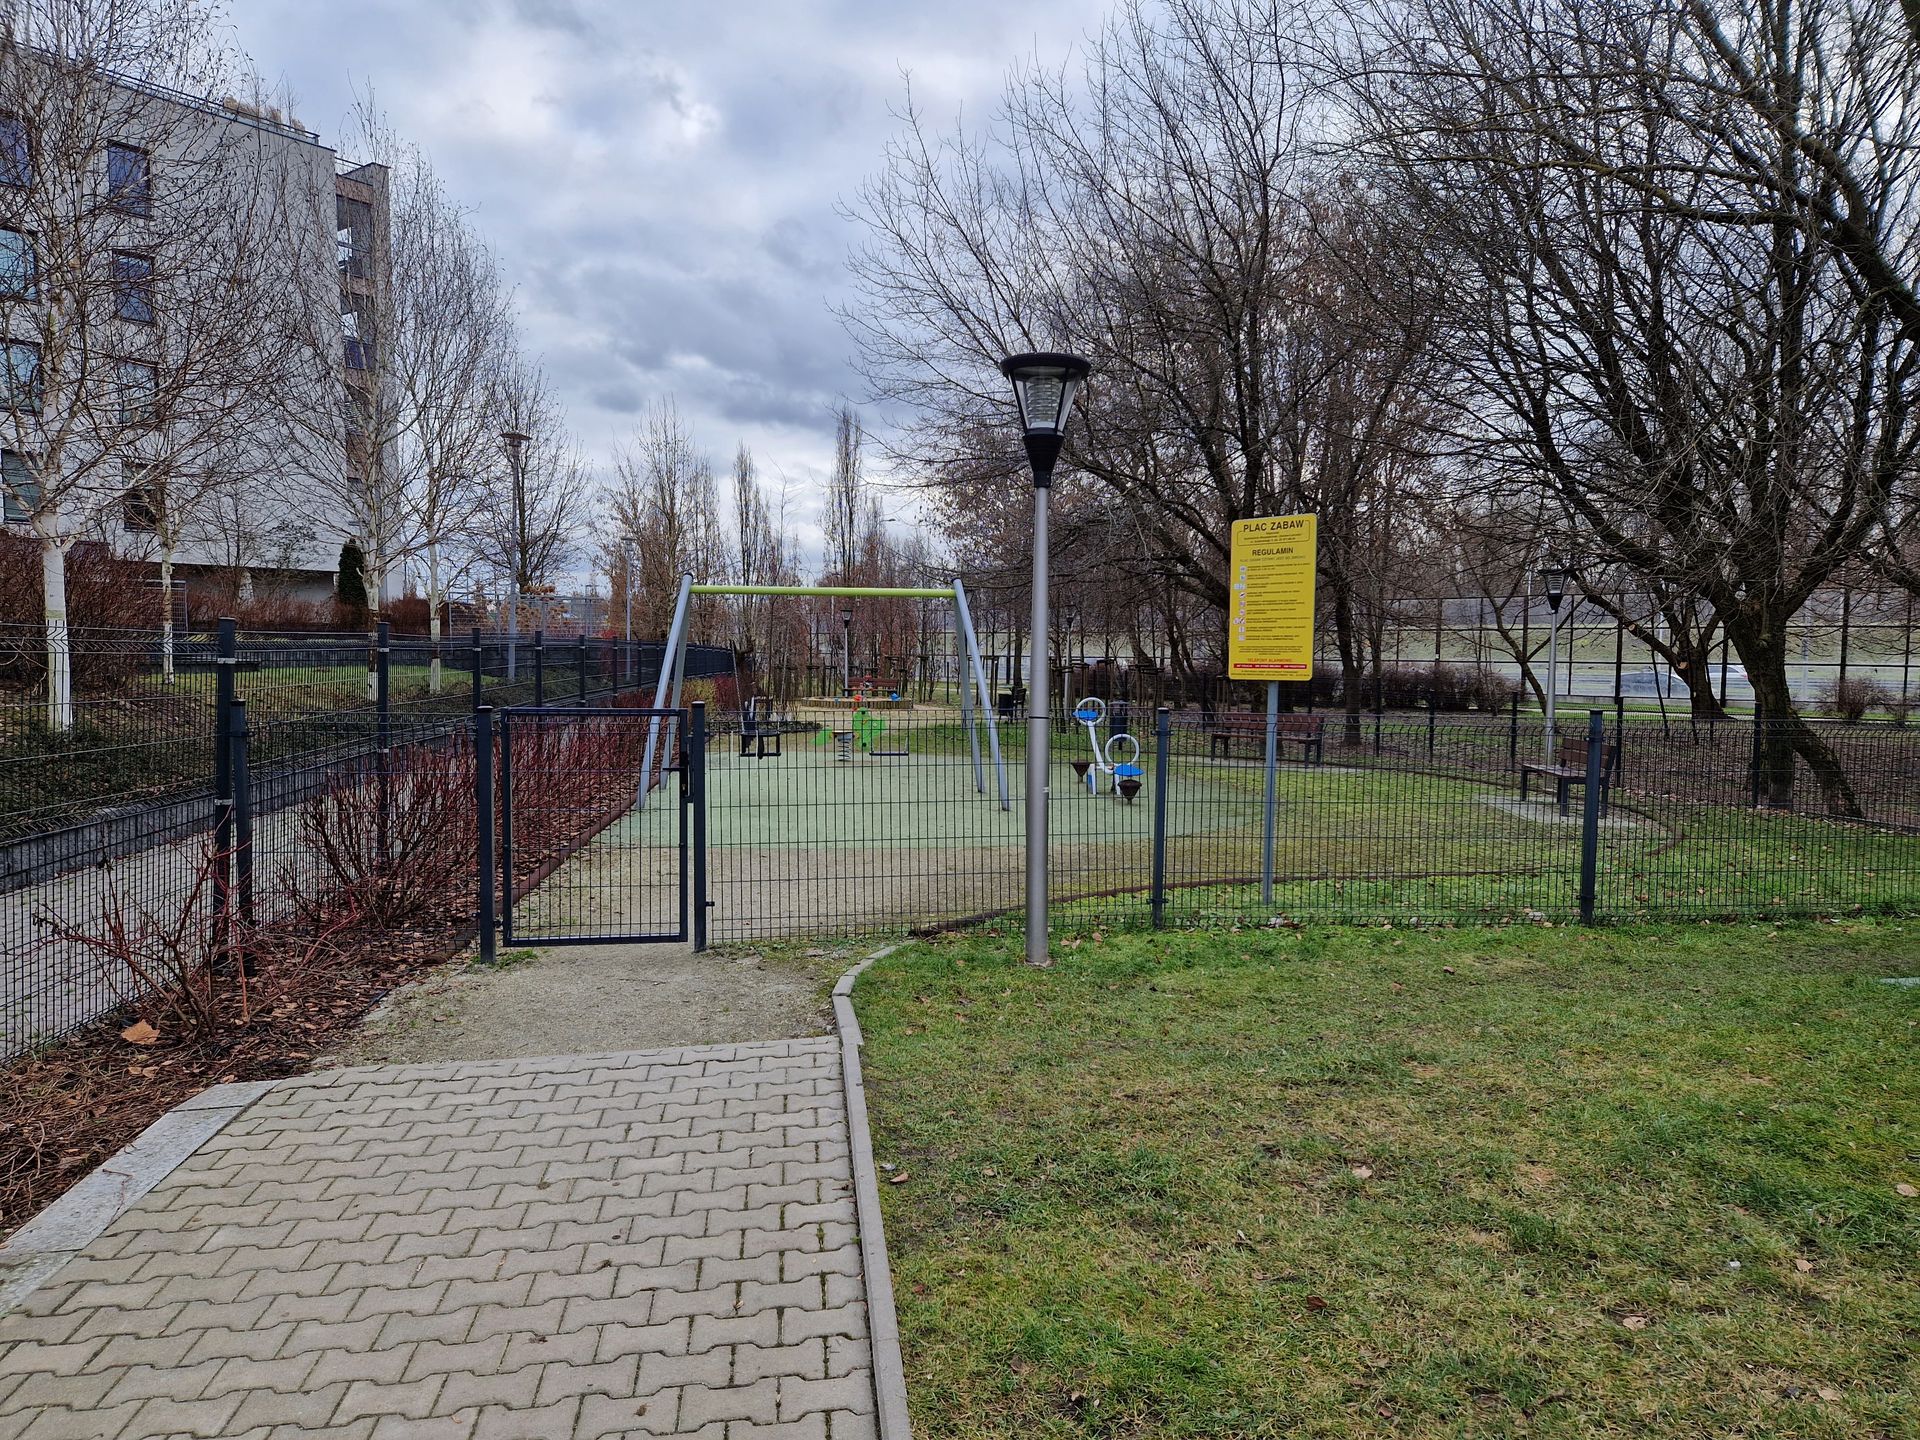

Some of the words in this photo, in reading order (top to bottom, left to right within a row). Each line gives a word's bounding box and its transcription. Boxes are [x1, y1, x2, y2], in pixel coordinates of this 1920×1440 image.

[1243, 522, 1267, 532] PLAC
[1270, 520, 1304, 531] ZABAW
[1252, 547, 1294, 556] REGULAMIN
